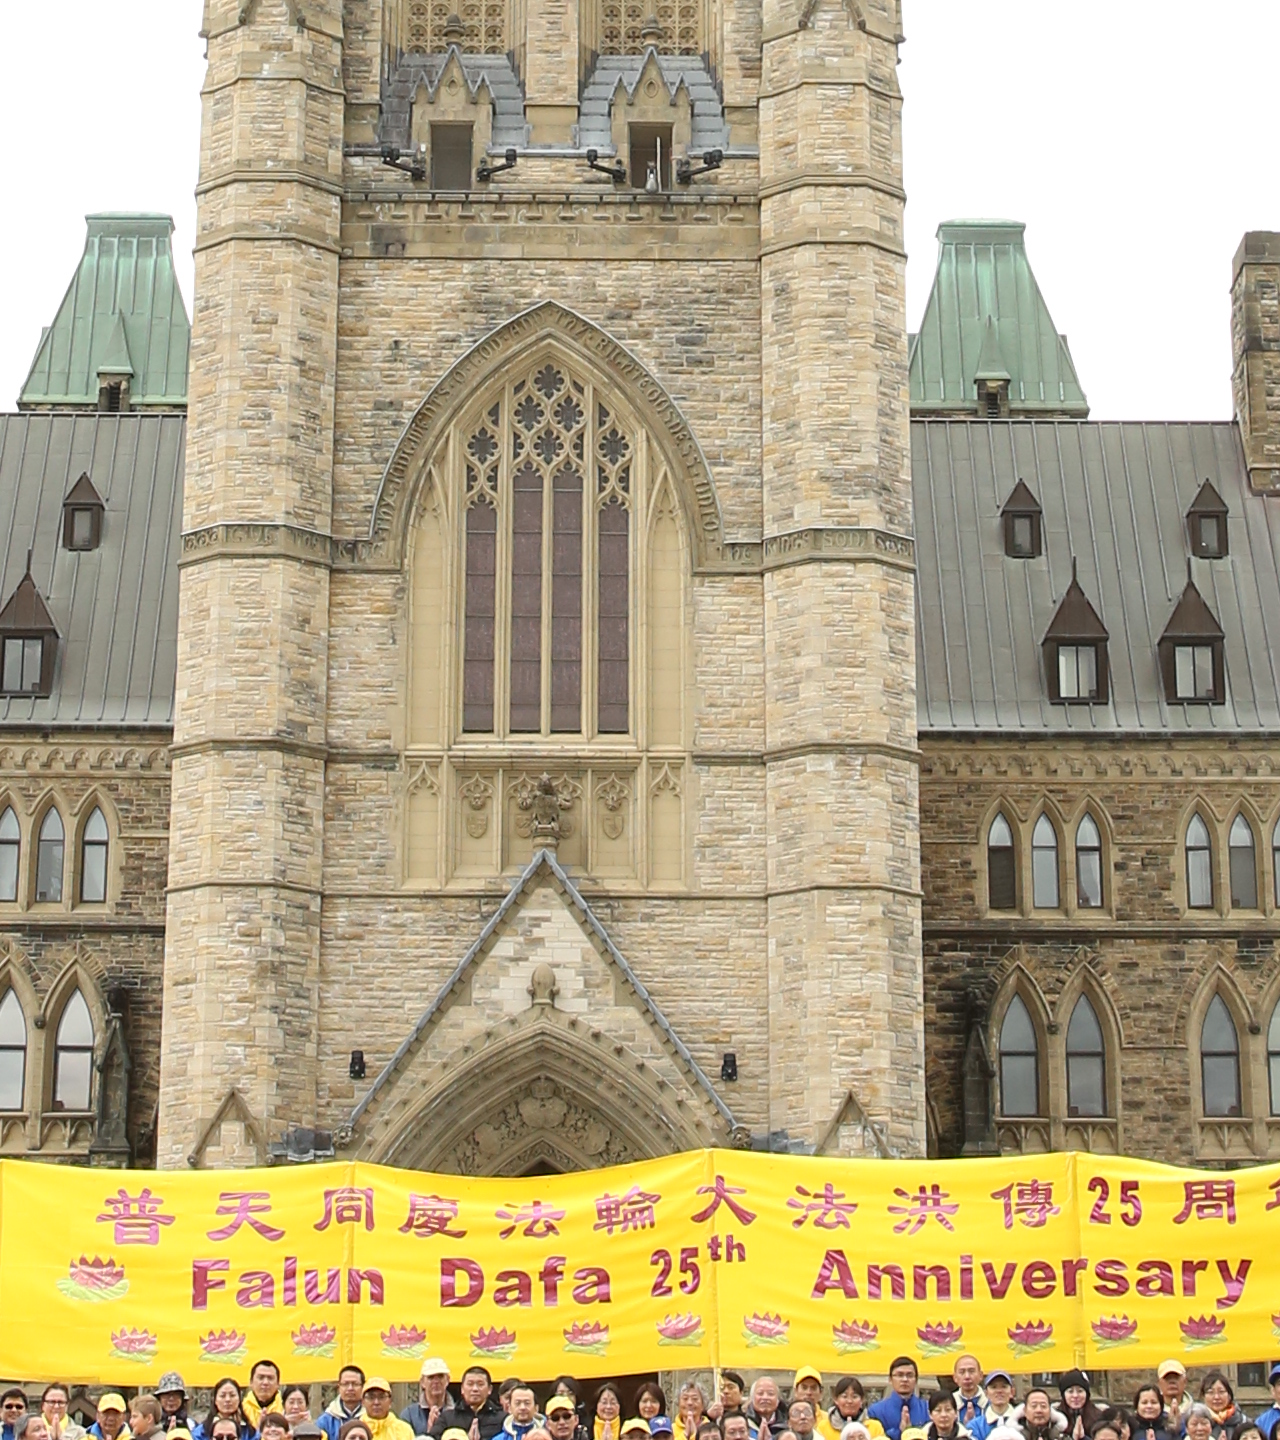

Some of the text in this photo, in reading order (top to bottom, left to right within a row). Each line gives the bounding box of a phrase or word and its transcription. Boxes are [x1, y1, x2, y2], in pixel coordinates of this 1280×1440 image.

[191, 1234, 1252, 1310] Falun Dafa 25th Anniversary
